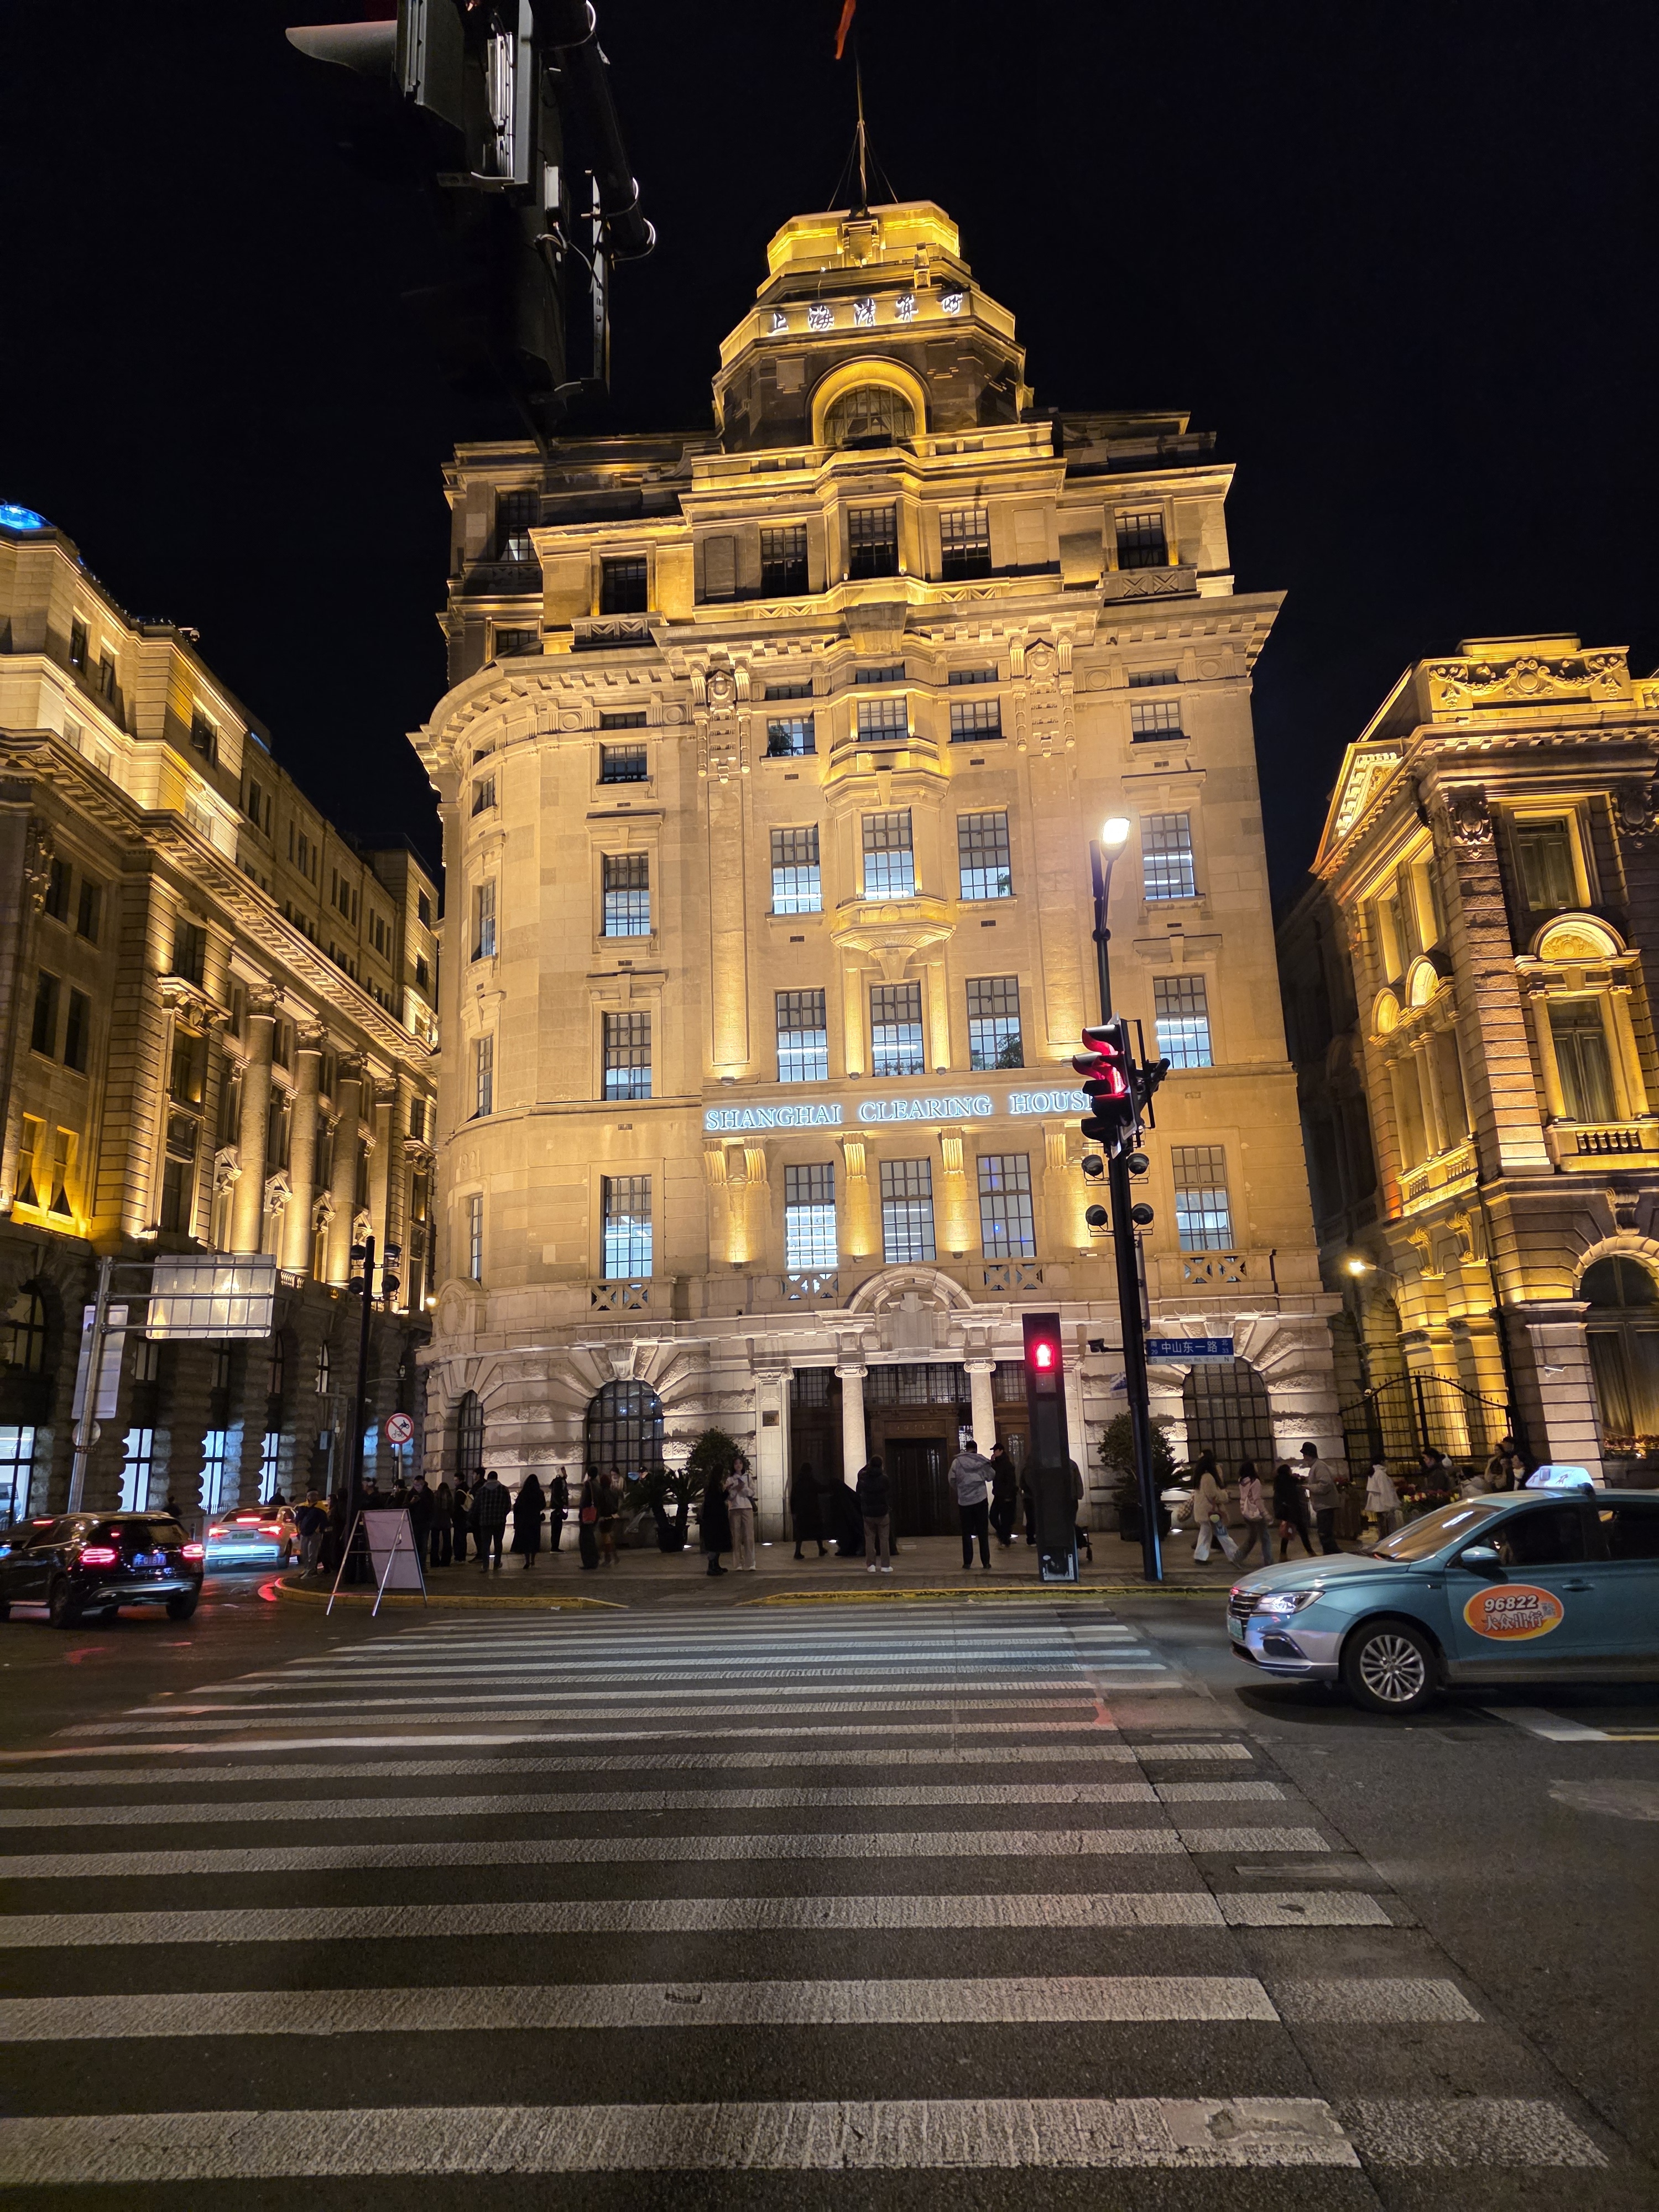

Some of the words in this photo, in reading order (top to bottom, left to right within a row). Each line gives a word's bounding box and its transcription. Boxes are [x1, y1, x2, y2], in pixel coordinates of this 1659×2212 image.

[707, 1105, 842, 1129] SHANGHAI
[860, 1095, 992, 1122] CLEARING
[1161, 1340, 1218, 1353] 中山东一路
[1484, 1595, 1538, 1612] 96822
[1482, 1611, 1544, 1631] 大众出行
